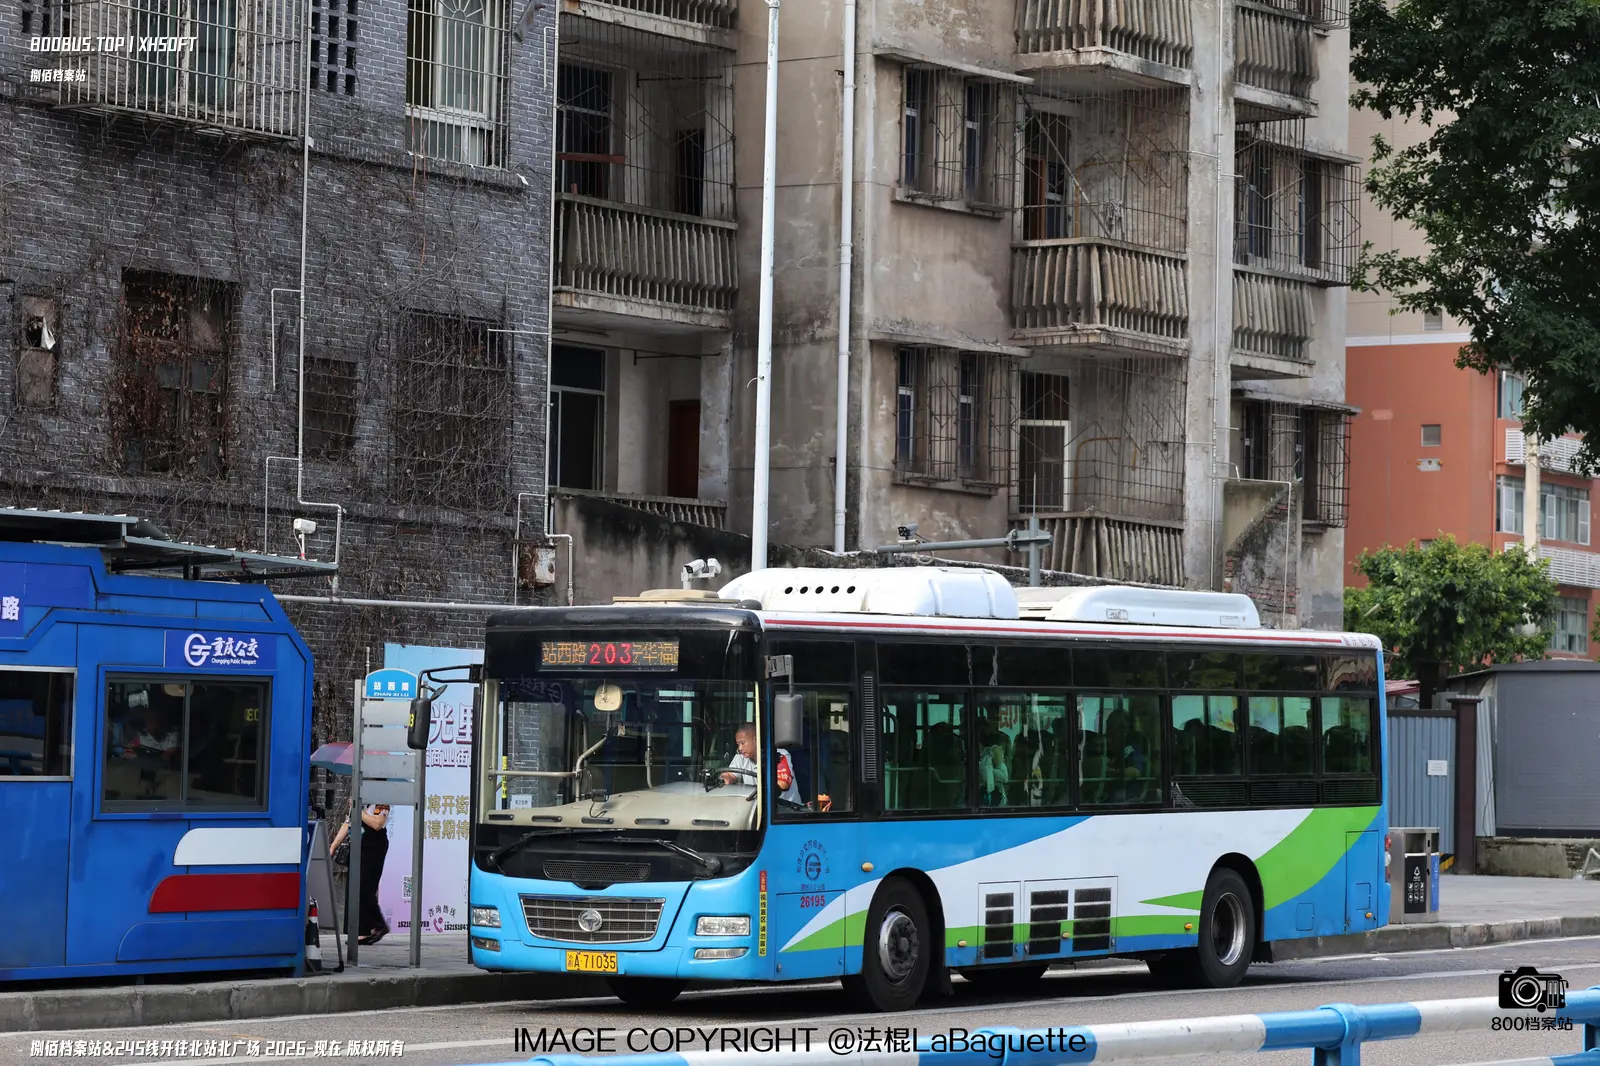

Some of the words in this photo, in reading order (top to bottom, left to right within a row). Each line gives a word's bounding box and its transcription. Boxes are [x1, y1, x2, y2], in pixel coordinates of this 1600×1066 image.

[2, 596, 20, 620] 路
[211, 636, 259, 658] 重庆公交
[542, 642, 586, 664] 站西路
[590, 643, 632, 664] 203
[425, 794, 469, 815] 将开街
[424, 820, 469, 840] 请期待
[800, 895, 826, 908] 26195
